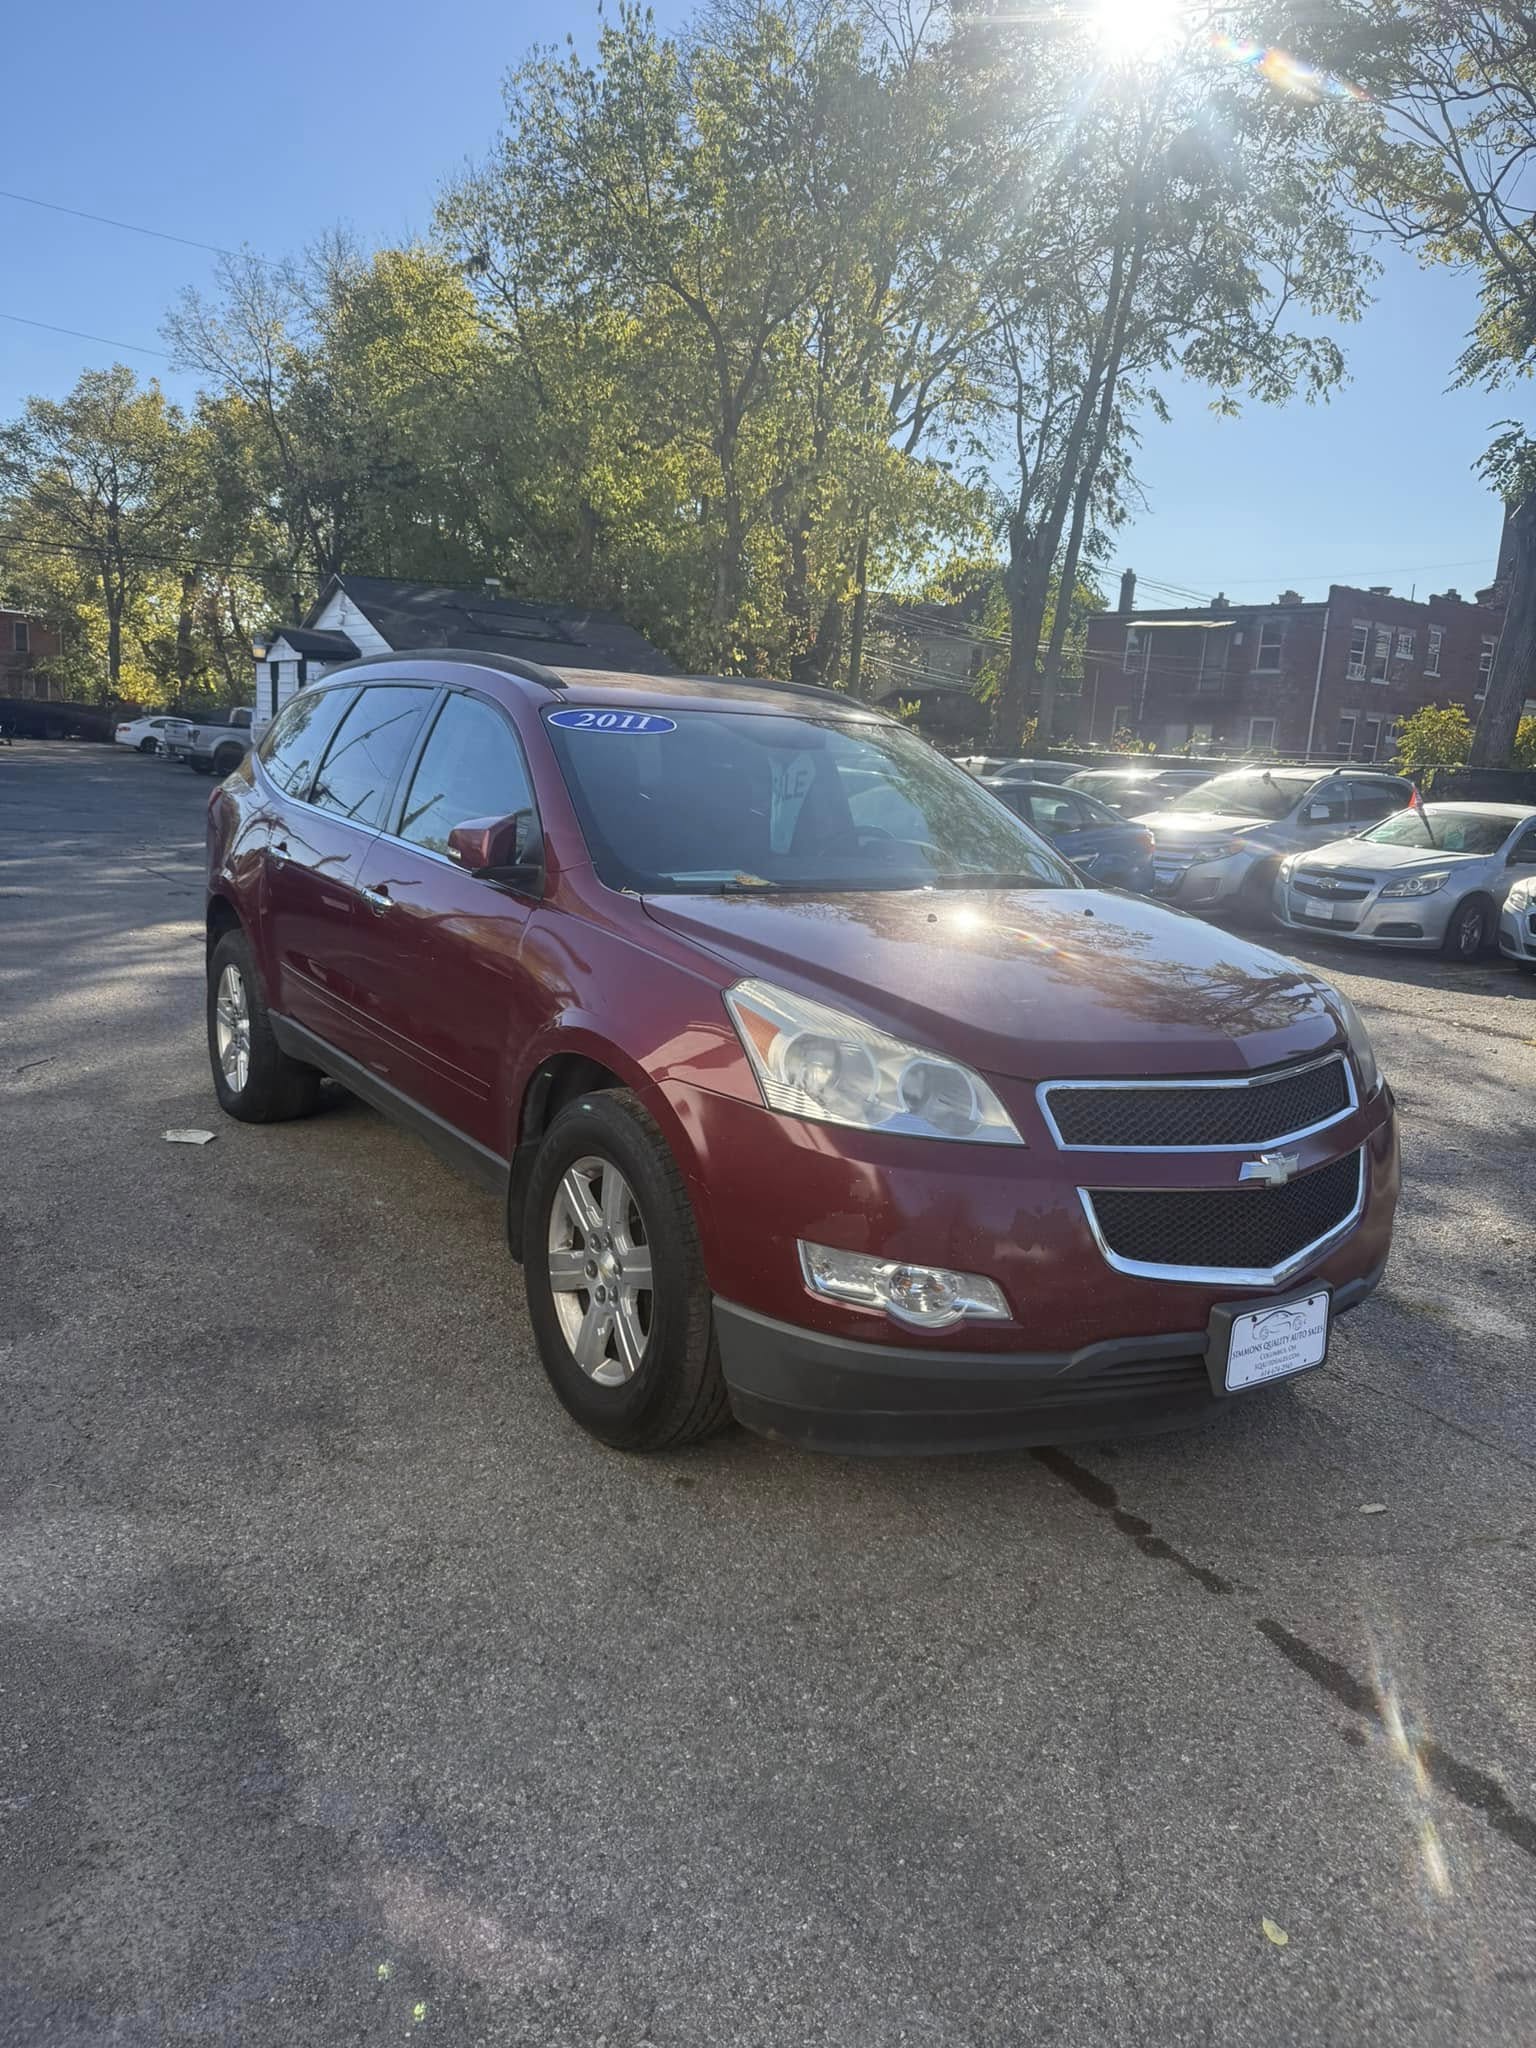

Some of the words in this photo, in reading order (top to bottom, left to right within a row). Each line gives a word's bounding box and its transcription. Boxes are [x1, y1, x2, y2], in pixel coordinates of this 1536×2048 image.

[574, 713, 652, 729] 2011
[1232, 1345, 1262, 1359] SIMMONS
[1263, 1336, 1289, 1350] QUALITY
[1291, 1330, 1308, 1341] AUTO
[1308, 1325, 1323, 1336] SALES
